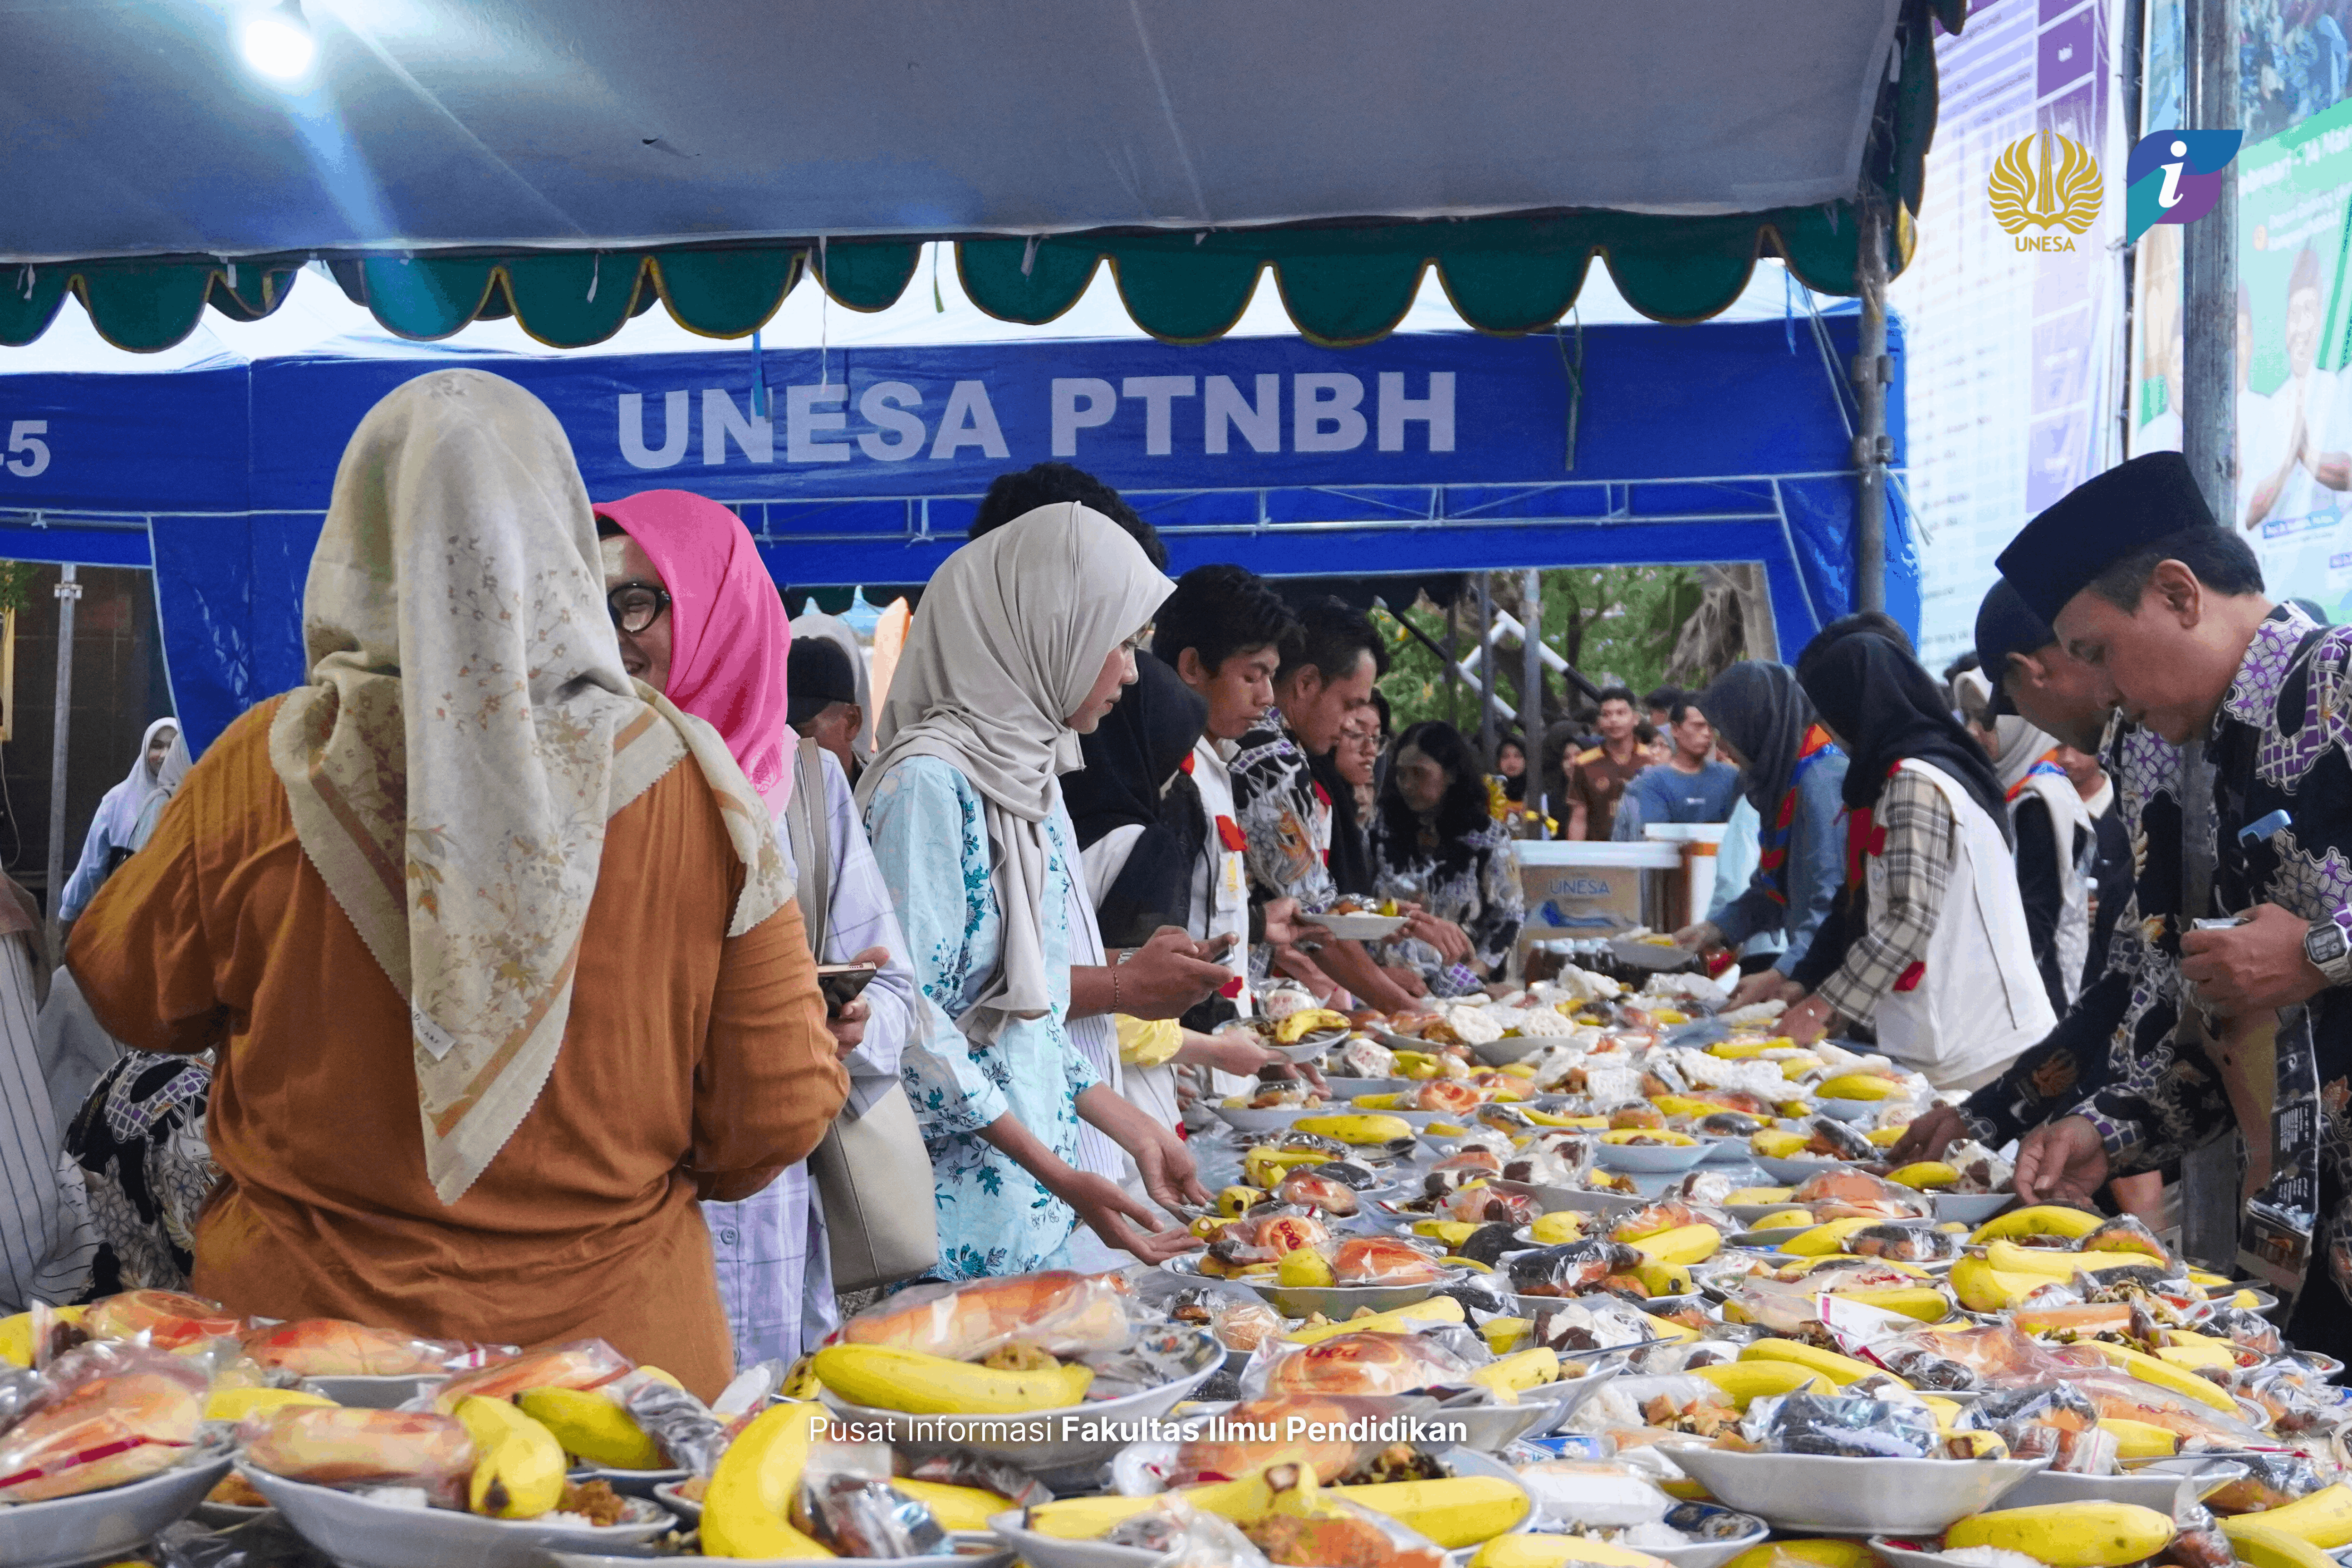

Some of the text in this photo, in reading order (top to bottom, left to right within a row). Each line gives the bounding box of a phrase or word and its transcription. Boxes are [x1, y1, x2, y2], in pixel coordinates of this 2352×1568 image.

[0, 420, 50, 477] 5
[618, 372, 1455, 469] UNESA PTNBH
[1550, 879, 1610, 894] UNESA
